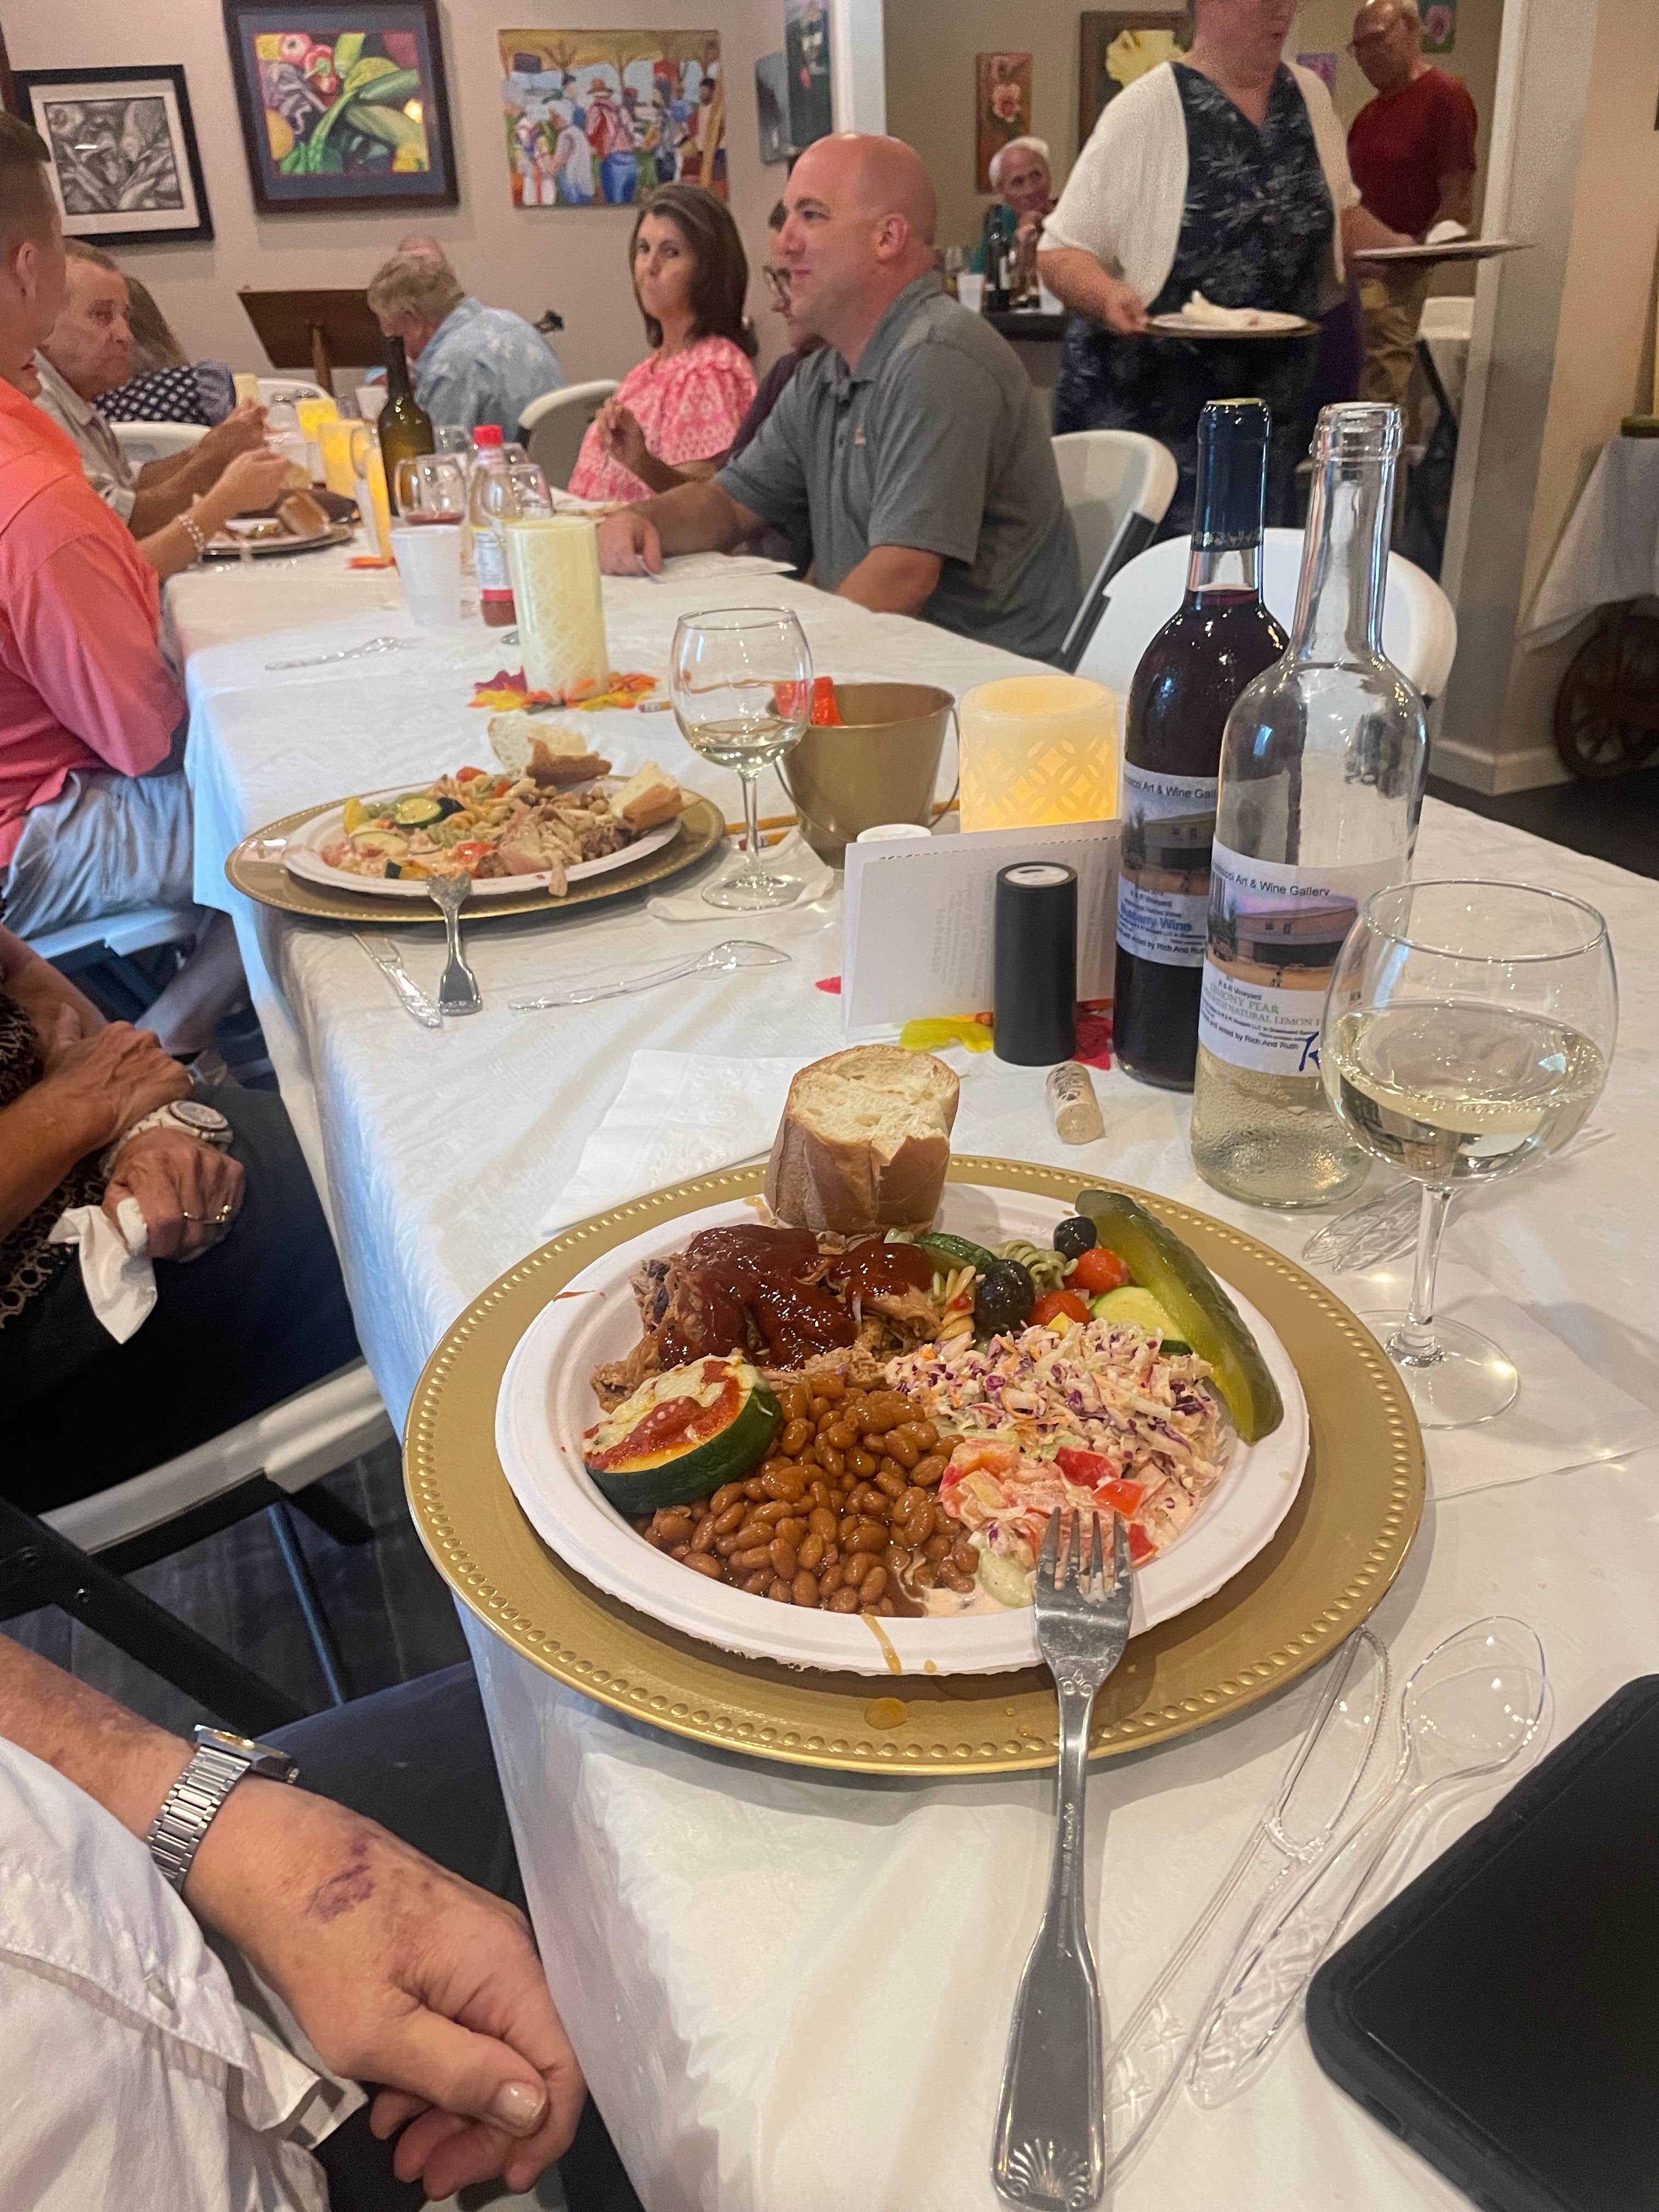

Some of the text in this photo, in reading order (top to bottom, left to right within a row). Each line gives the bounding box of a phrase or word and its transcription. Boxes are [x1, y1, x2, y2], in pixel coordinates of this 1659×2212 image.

[1143, 781, 1154, 793] Art
[1166, 786, 1192, 799] Wine
[1235, 874, 1330, 897] Art & Wine Gallery
[1160, 917, 1193, 932] Wine
[1249, 1000, 1279, 1014] PEAR
[1274, 1016, 1313, 1026] LEMON
[1235, 1032, 1243, 1041] by
[1244, 1035, 1261, 1045] Rich
[1280, 1041, 1299, 1050] Ruth
